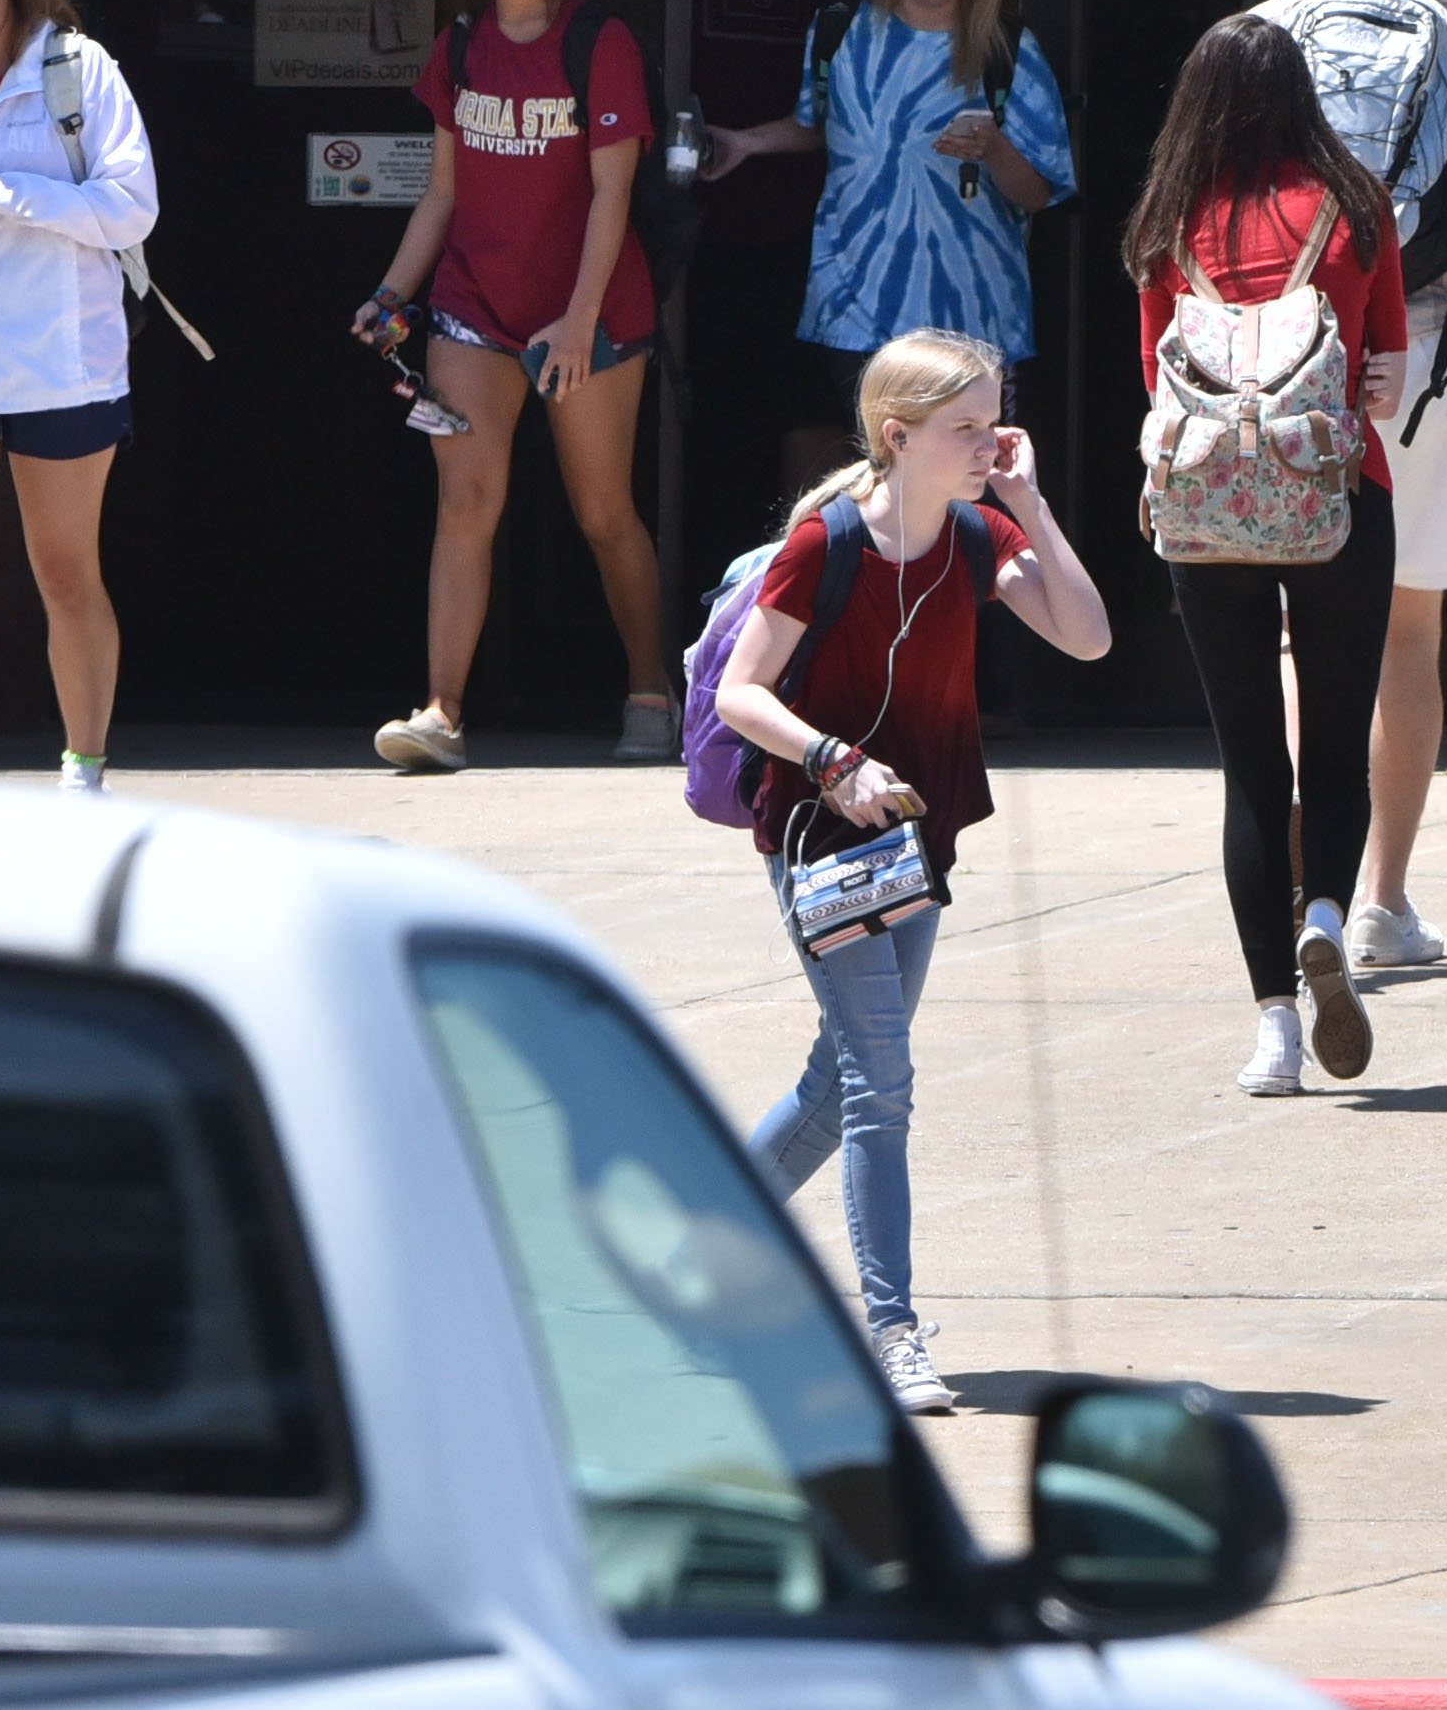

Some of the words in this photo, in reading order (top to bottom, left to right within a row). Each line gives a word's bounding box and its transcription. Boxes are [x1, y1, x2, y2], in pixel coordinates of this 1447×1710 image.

[269, 58, 420, 80] VIPdecals.com
[455, 88, 515, 138] ORIDA
[522, 97, 578, 138] STA
[394, 140, 434, 149] WELC
[464, 130, 547, 155] UNIVERSITY
